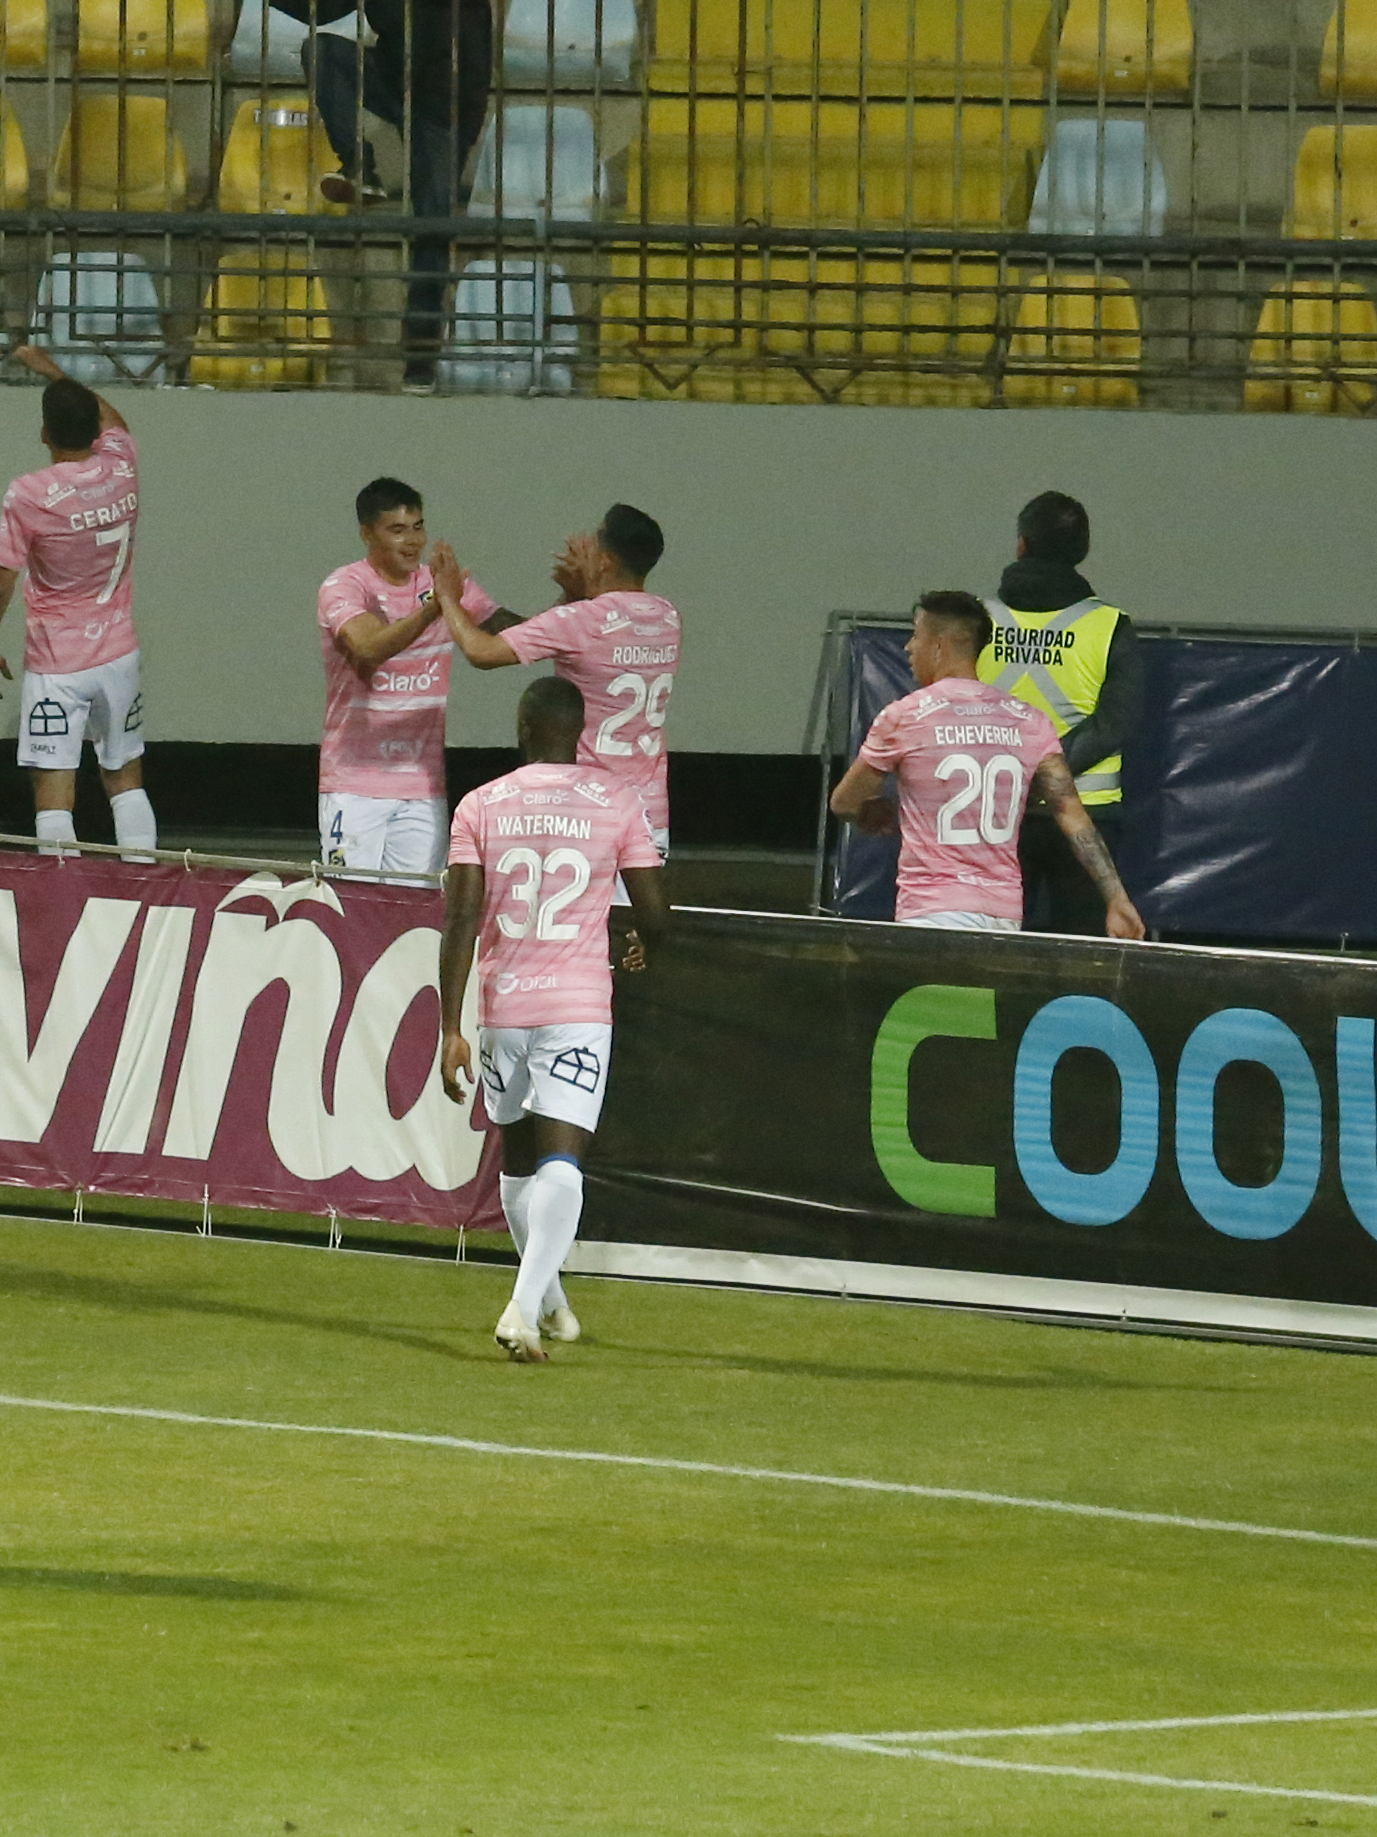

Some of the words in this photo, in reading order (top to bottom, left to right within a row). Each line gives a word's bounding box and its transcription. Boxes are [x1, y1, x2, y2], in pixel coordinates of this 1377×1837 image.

[70, 492, 139, 531] CERATO
[94, 521, 133, 605] 7
[989, 626, 1075, 649] EGURIDAD
[612, 644, 679, 666] RODRIGUE
[994, 645, 1064, 667] PRIVADA
[371, 668, 434, 693] Claro
[594, 672, 674, 757] 29
[934, 724, 1024, 748] ECHEVERRIA
[934, 752, 1024, 846] 20
[330, 809, 343, 845] 4
[496, 814, 593, 840] WATERMAN
[495, 846, 593, 941] 32
